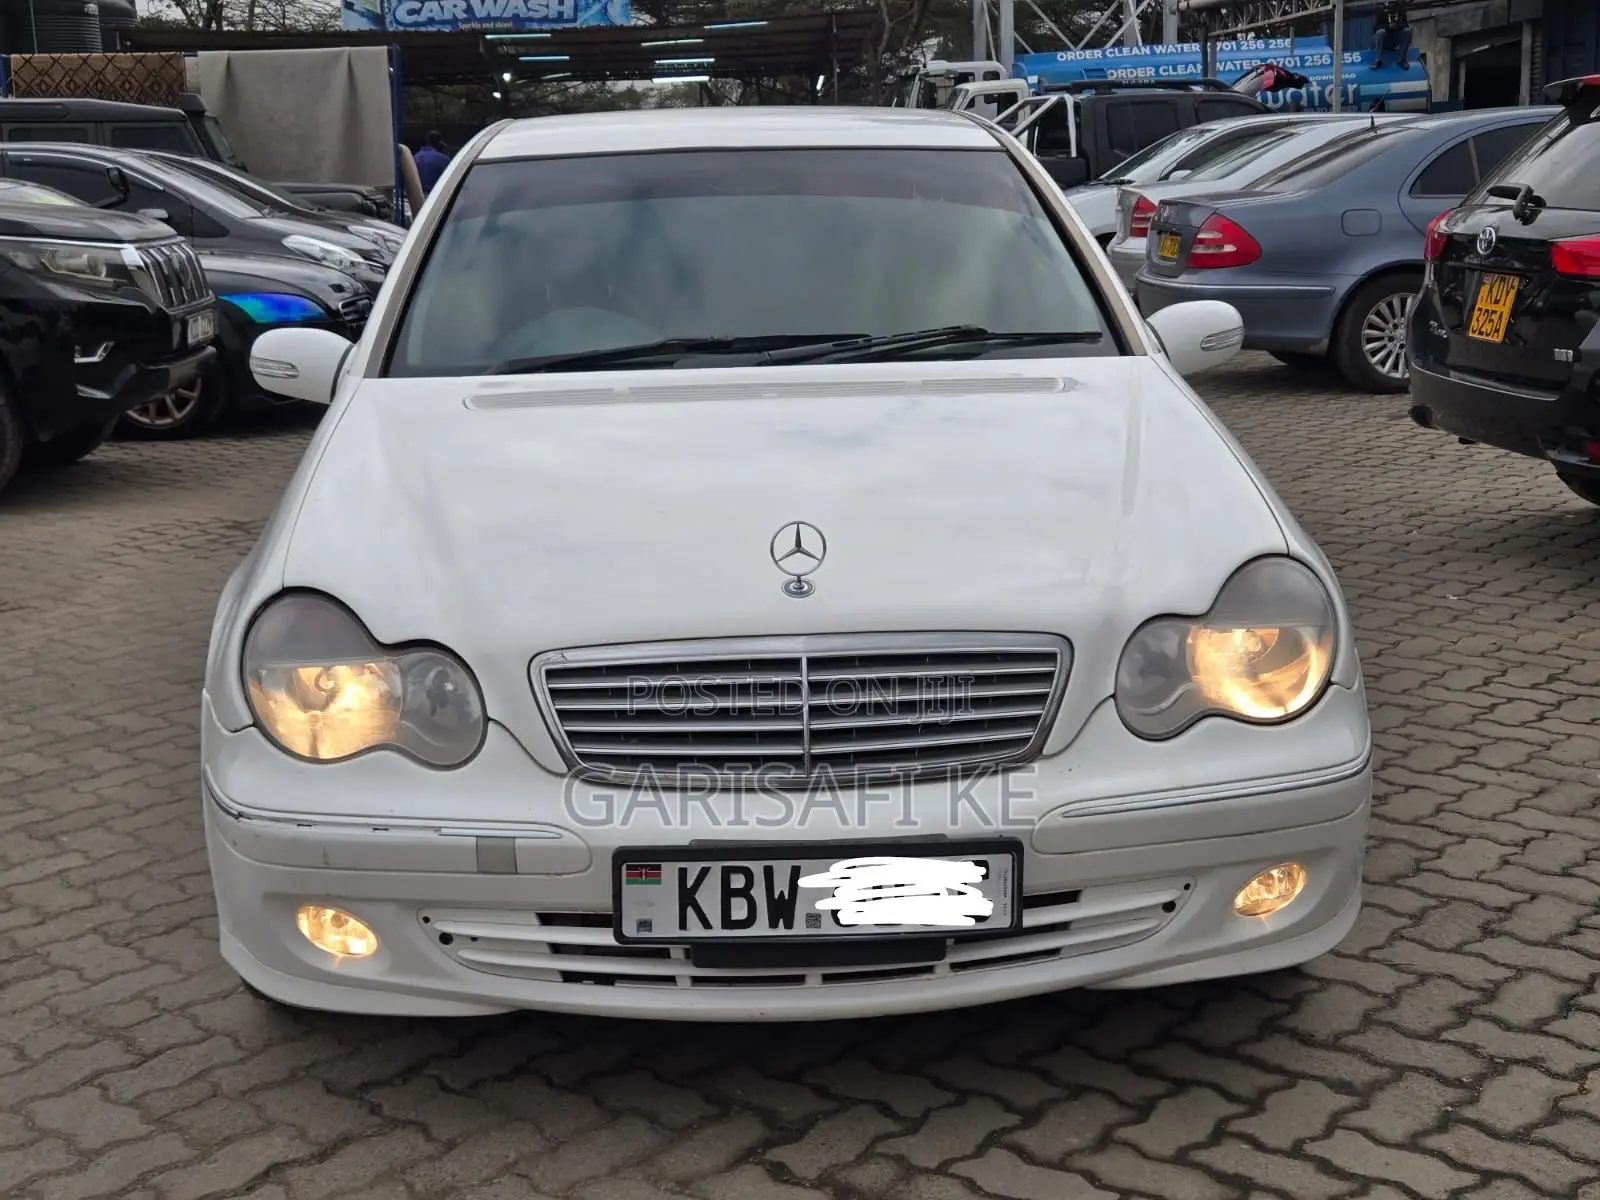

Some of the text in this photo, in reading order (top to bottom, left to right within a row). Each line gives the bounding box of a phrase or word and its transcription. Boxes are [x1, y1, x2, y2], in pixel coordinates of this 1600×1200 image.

[395, 0, 574, 23] CAR WASH
[1056, 51, 1103, 62] ORDER
[1105, 46, 1150, 58] CLEAN
[1152, 42, 1201, 55] WATER
[1241, 39, 1265, 50] 256
[1269, 37, 1292, 49] 256
[1106, 67, 1156, 80] ORDER
[1304, 54, 1331, 67] 256
[1340, 51, 1362, 64] 56
[1471, 306, 1505, 339] 325A
[677, 864, 800, 932] KBW
